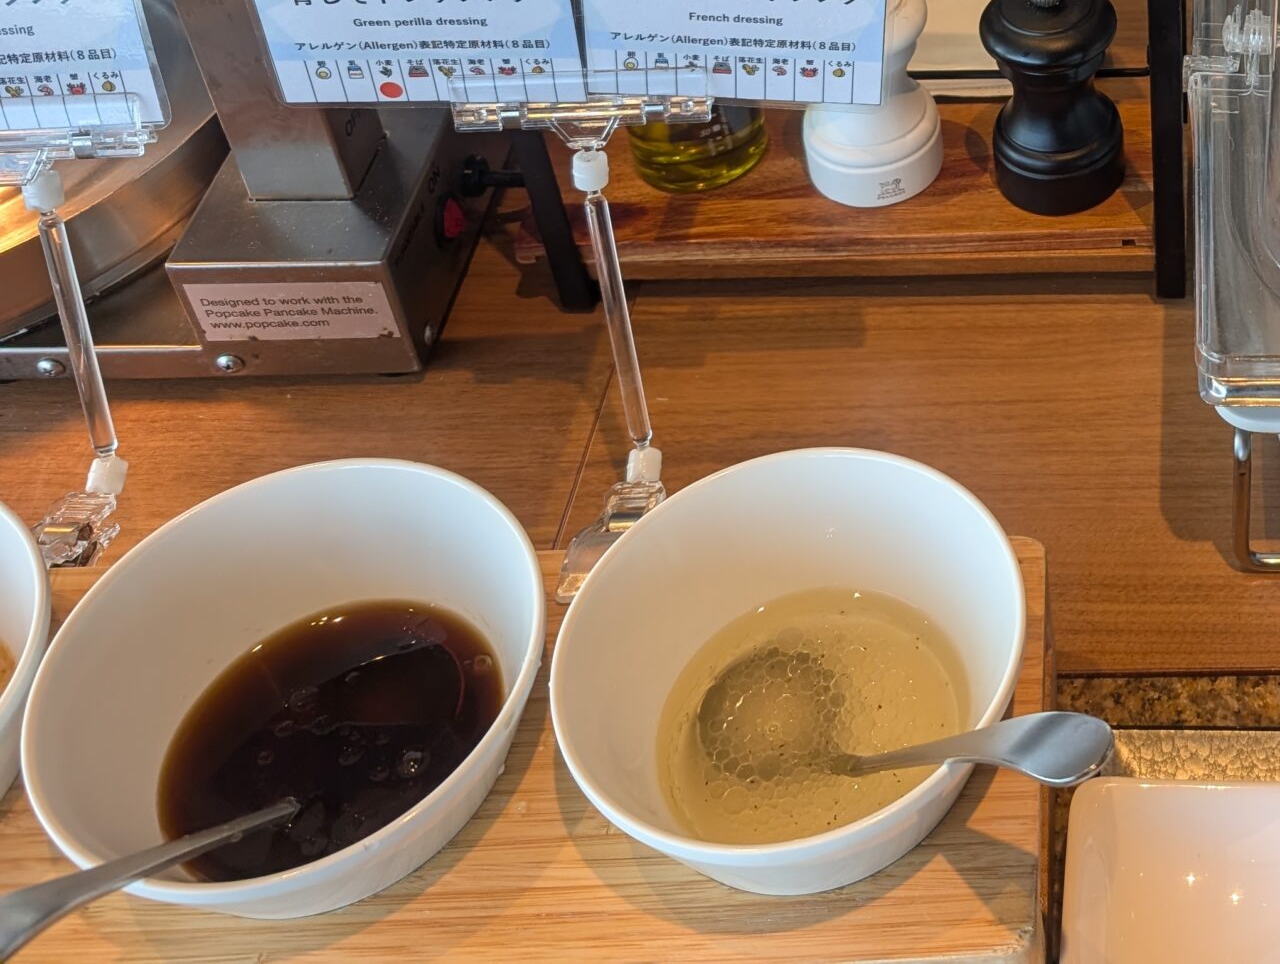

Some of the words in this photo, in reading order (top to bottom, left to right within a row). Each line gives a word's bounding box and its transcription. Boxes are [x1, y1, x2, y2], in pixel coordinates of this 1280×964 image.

[353, 17, 391, 27] Green
[394, 16, 432, 28] perilla
[435, 16, 488, 27] dressing
[689, 12, 730, 23] French
[733, 14, 783, 26] dressing
[0, 25, 35, 36] ssing
[200, 298, 259, 308] Designed
[279, 296, 310, 305] work
[313, 296, 339, 304] with
[343, 296, 363, 304] the
[205, 309, 261, 318] Popcake
[264, 308, 318, 317] Pancake
[321, 307, 378, 315] Machine.
[210, 319, 330, 329] www.popcake.com
